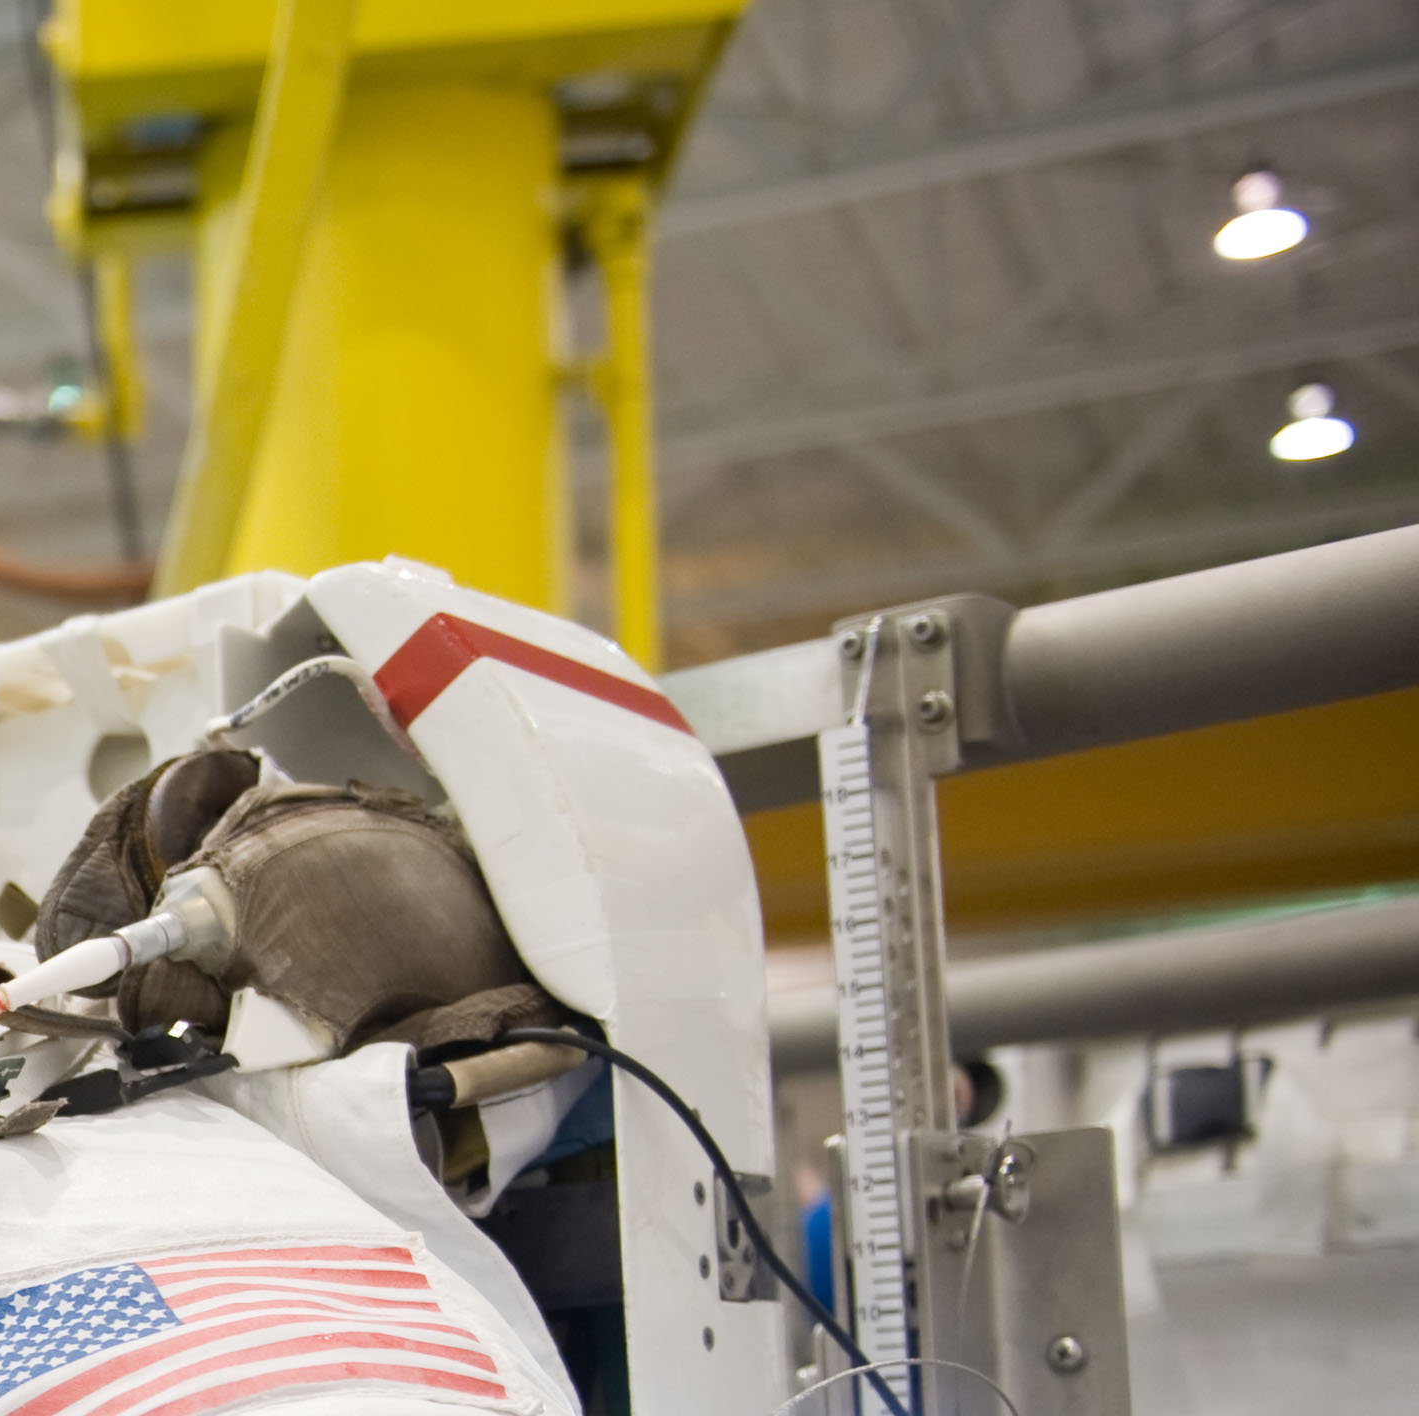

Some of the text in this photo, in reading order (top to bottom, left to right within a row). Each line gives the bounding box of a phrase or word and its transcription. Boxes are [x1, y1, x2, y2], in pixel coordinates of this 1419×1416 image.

[828, 851, 851, 868] 17
[842, 1044, 864, 1060] 14
[847, 1108, 869, 1128] 13
[851, 1175, 874, 1193] 12
[854, 1241, 875, 1258] 11
[858, 1305, 881, 1323] 10
